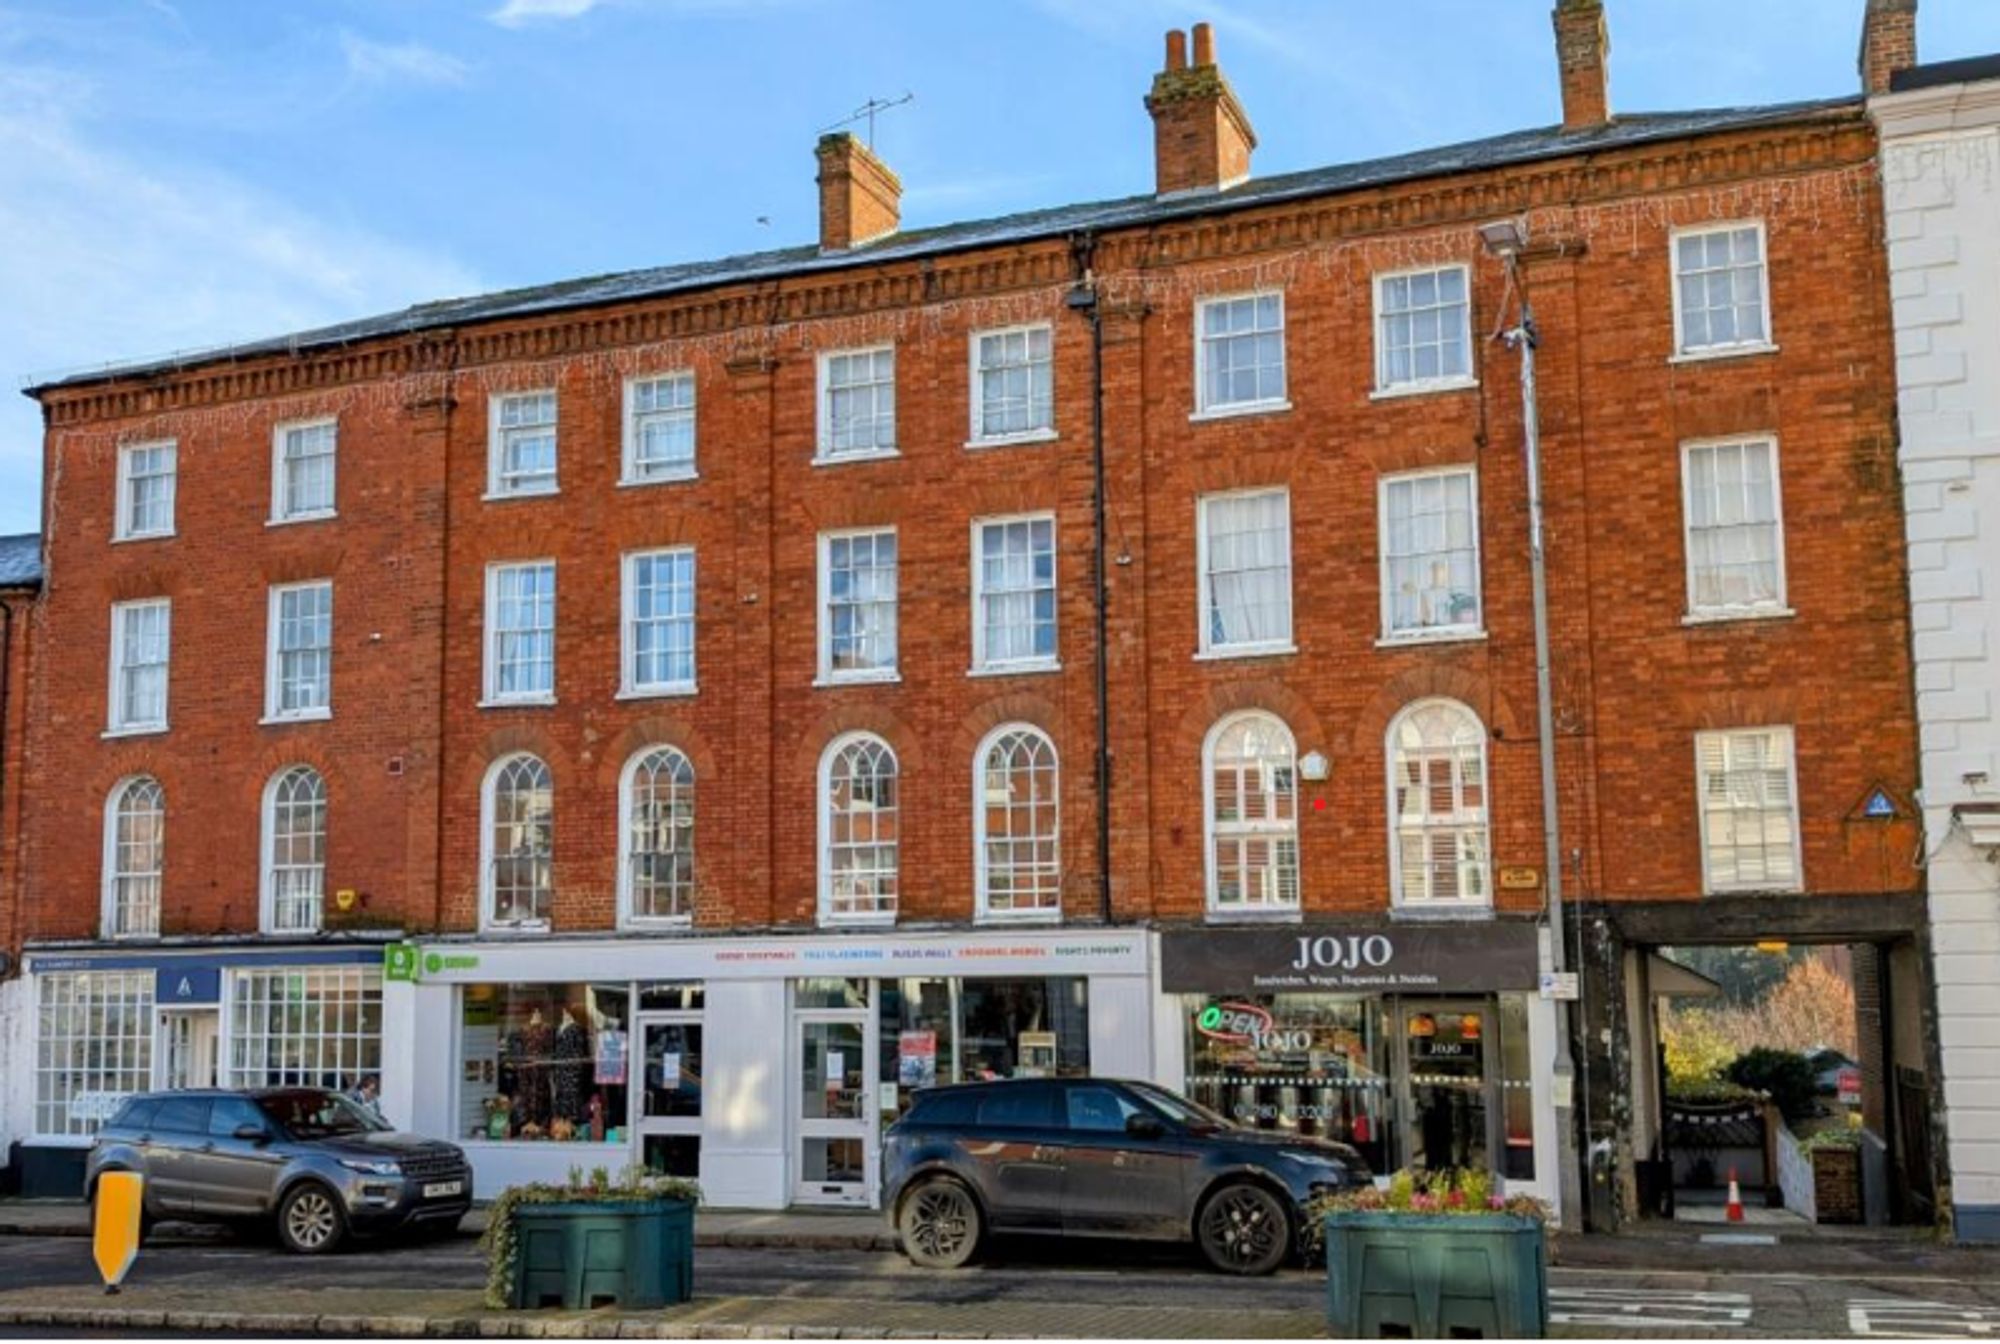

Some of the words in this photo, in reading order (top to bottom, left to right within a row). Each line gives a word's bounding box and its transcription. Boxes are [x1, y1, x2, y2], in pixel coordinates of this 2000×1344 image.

[1292, 934, 1393, 970] JOJO
[1200, 1006, 1264, 1036] OPEN
[1250, 1030, 1311, 1052] JOJO
[1430, 1042, 1462, 1055] JOJO
